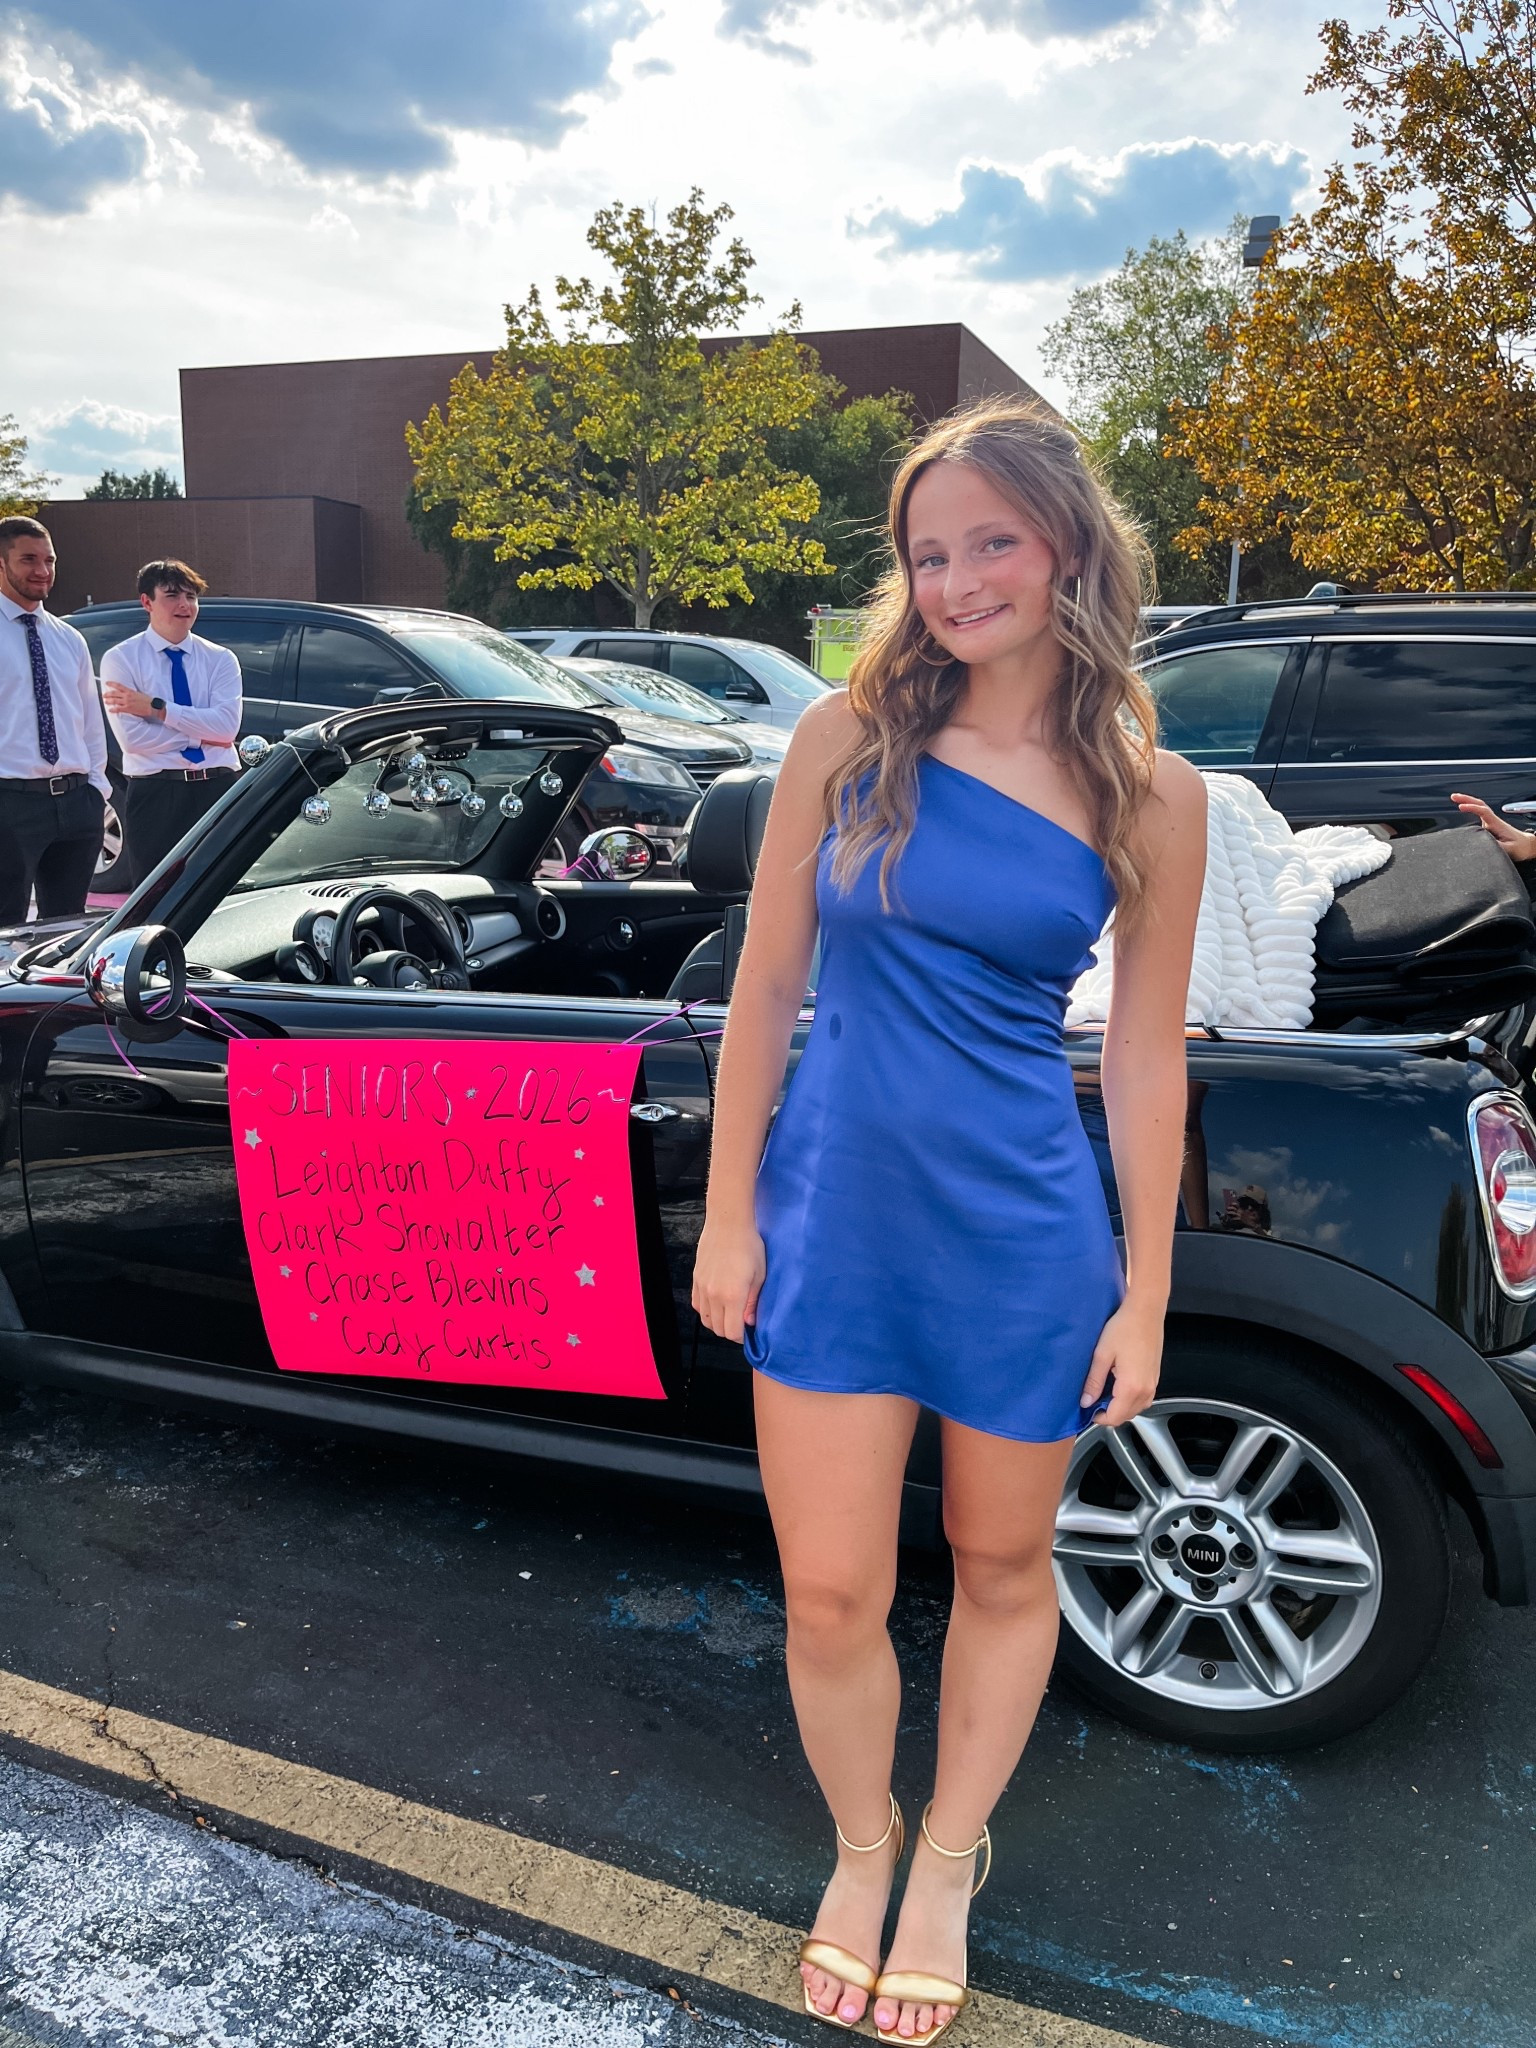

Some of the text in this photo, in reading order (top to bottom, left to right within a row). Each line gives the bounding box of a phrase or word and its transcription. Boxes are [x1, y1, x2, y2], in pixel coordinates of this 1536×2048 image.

[271, 1061, 591, 1126] SENIORS 2026
[269, 1139, 571, 1226] Leighton Duffy
[258, 1204, 566, 1257] Clark Showalter
[305, 1260, 549, 1315] Chase Blevins
[341, 1316, 552, 1372] Cody Curtis
[1187, 1548, 1219, 1562] MINI
